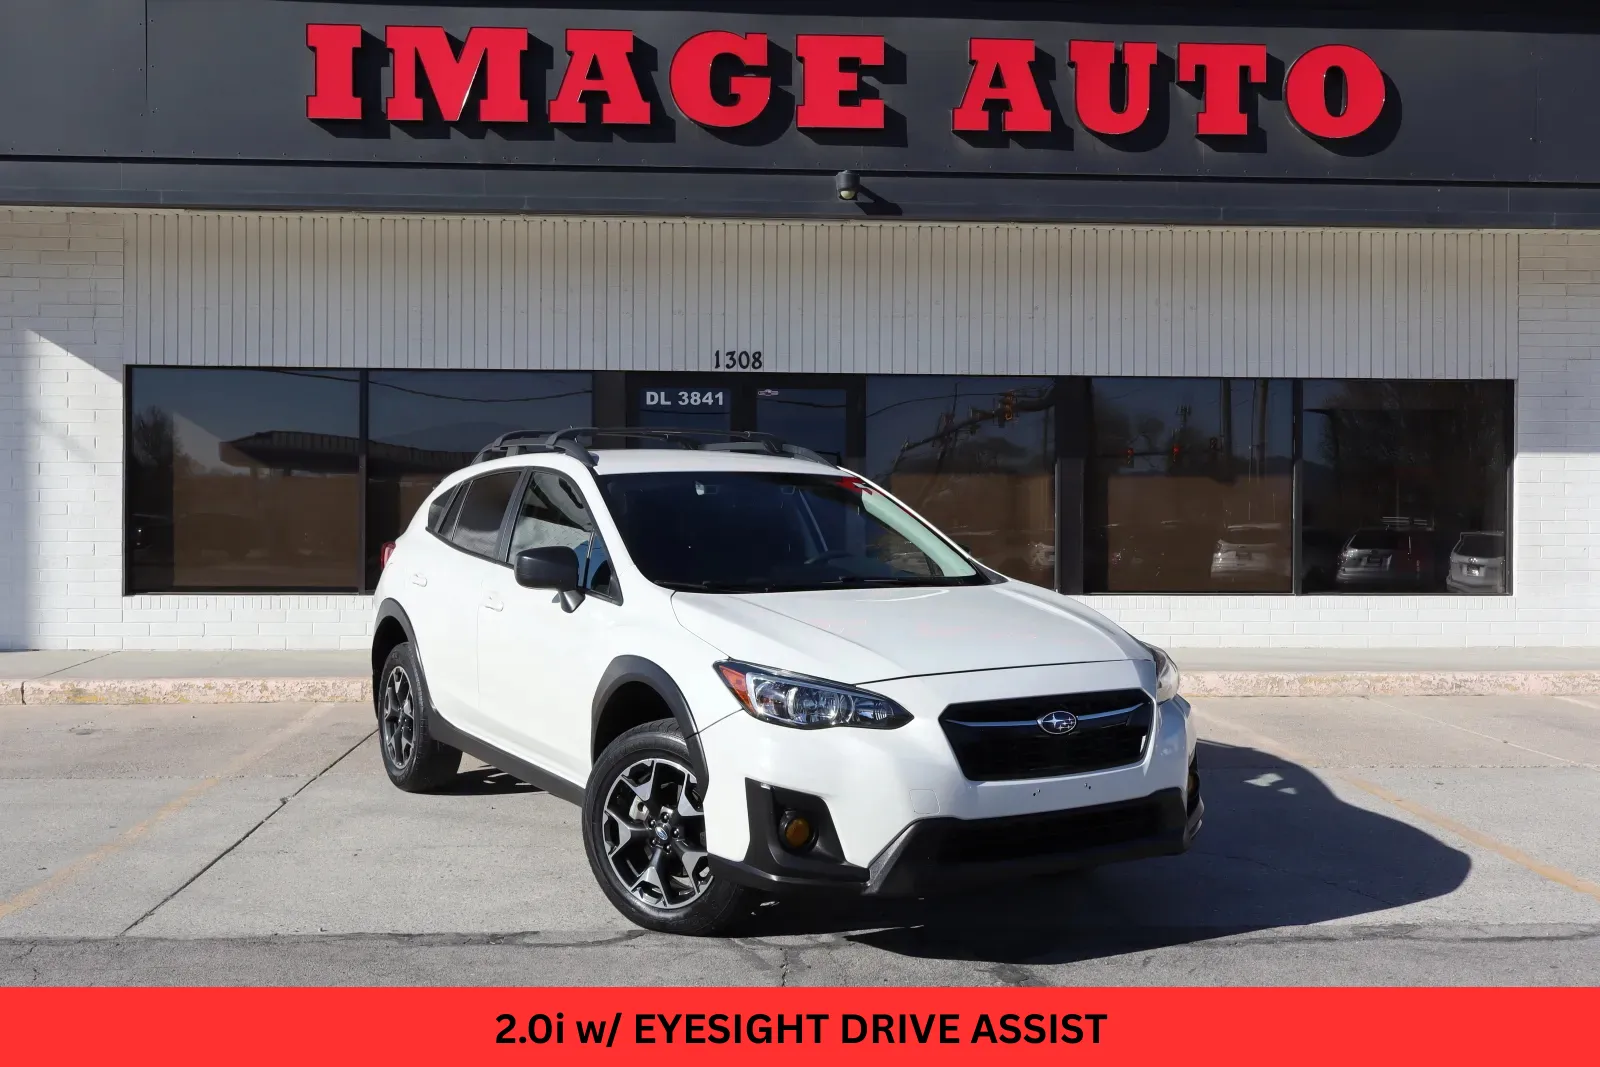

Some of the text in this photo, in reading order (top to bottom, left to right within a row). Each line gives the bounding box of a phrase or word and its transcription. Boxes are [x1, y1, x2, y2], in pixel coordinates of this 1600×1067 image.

[306, 23, 1387, 140] IMAGE AUTO
[713, 350, 763, 370] 1308
[646, 391, 724, 406] DL 3841
